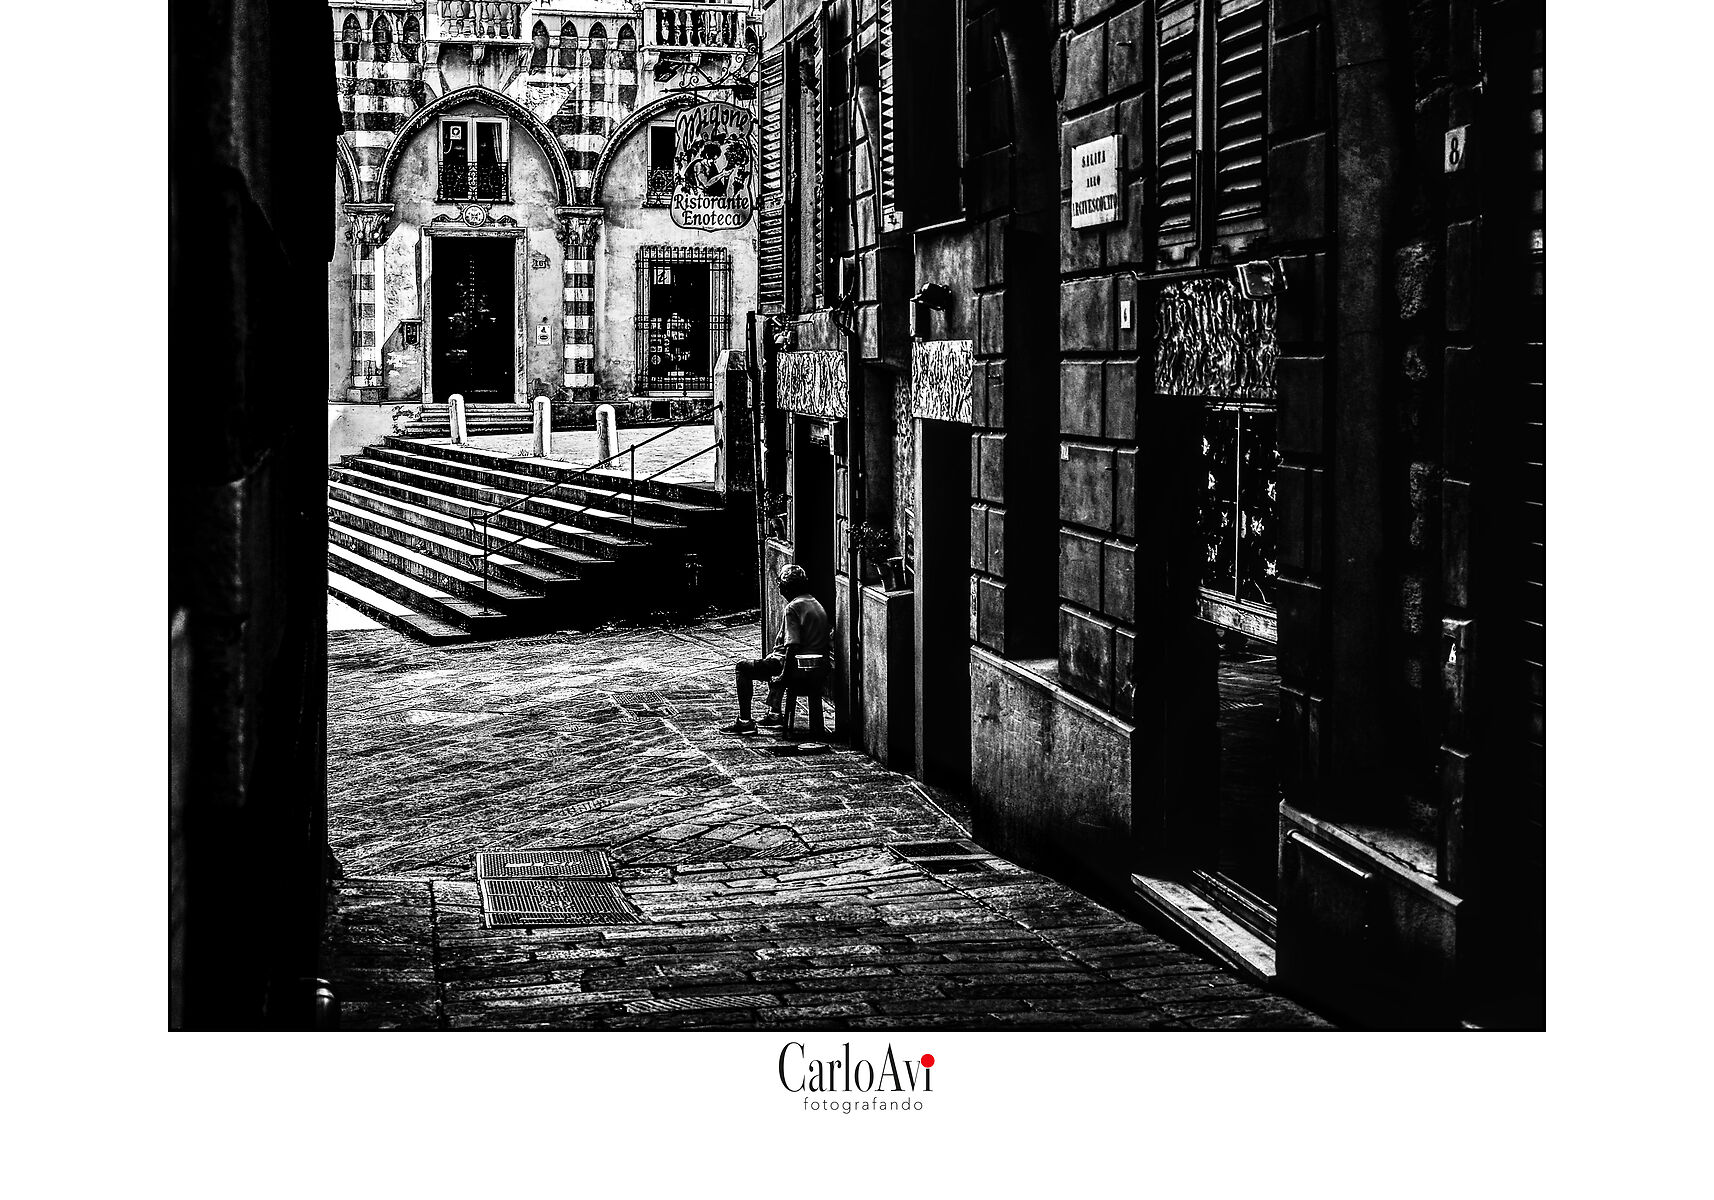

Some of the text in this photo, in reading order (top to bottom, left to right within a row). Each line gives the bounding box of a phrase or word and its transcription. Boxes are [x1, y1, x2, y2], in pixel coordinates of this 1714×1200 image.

[677, 103, 748, 150] Migone
[1449, 137, 1459, 165] 8
[674, 194, 749, 210] Ristorante
[682, 211, 742, 226] Enoteca
